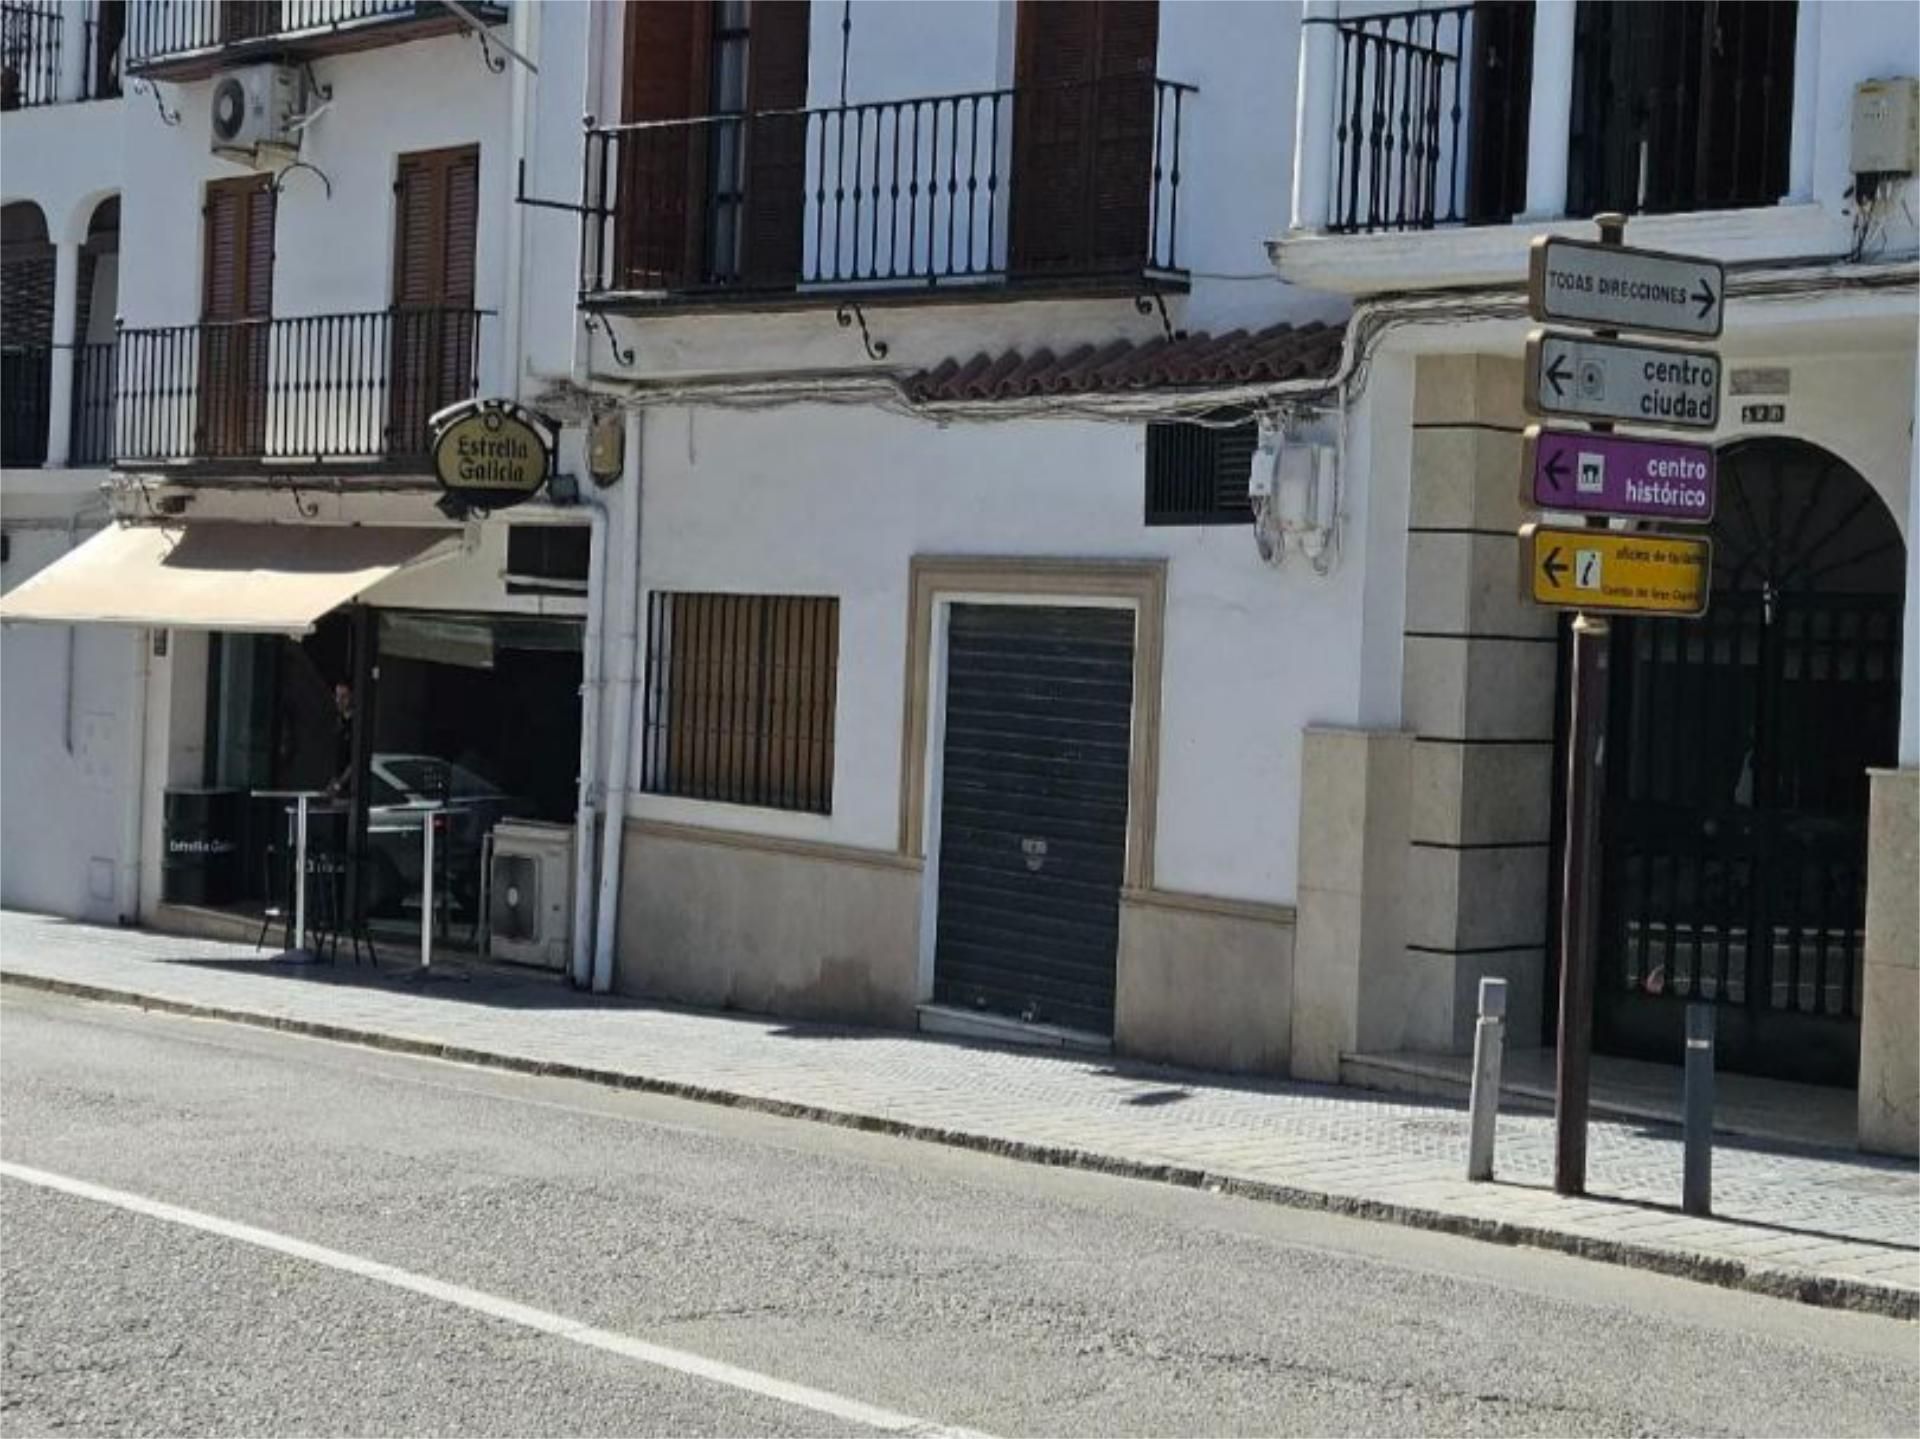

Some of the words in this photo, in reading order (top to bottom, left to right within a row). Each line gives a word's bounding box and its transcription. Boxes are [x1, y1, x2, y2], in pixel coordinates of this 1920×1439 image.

[1550, 271, 1594, 293] TODAS
[1599, 278, 1687, 305] DIRECCIONES
[1643, 359, 1713, 388] centro
[1640, 389, 1713, 420] ciudad
[457, 435, 528, 459] Estrella
[459, 457, 524, 482] Galicia
[1647, 457, 1707, 480] centro
[1625, 478, 1706, 507] histórico
